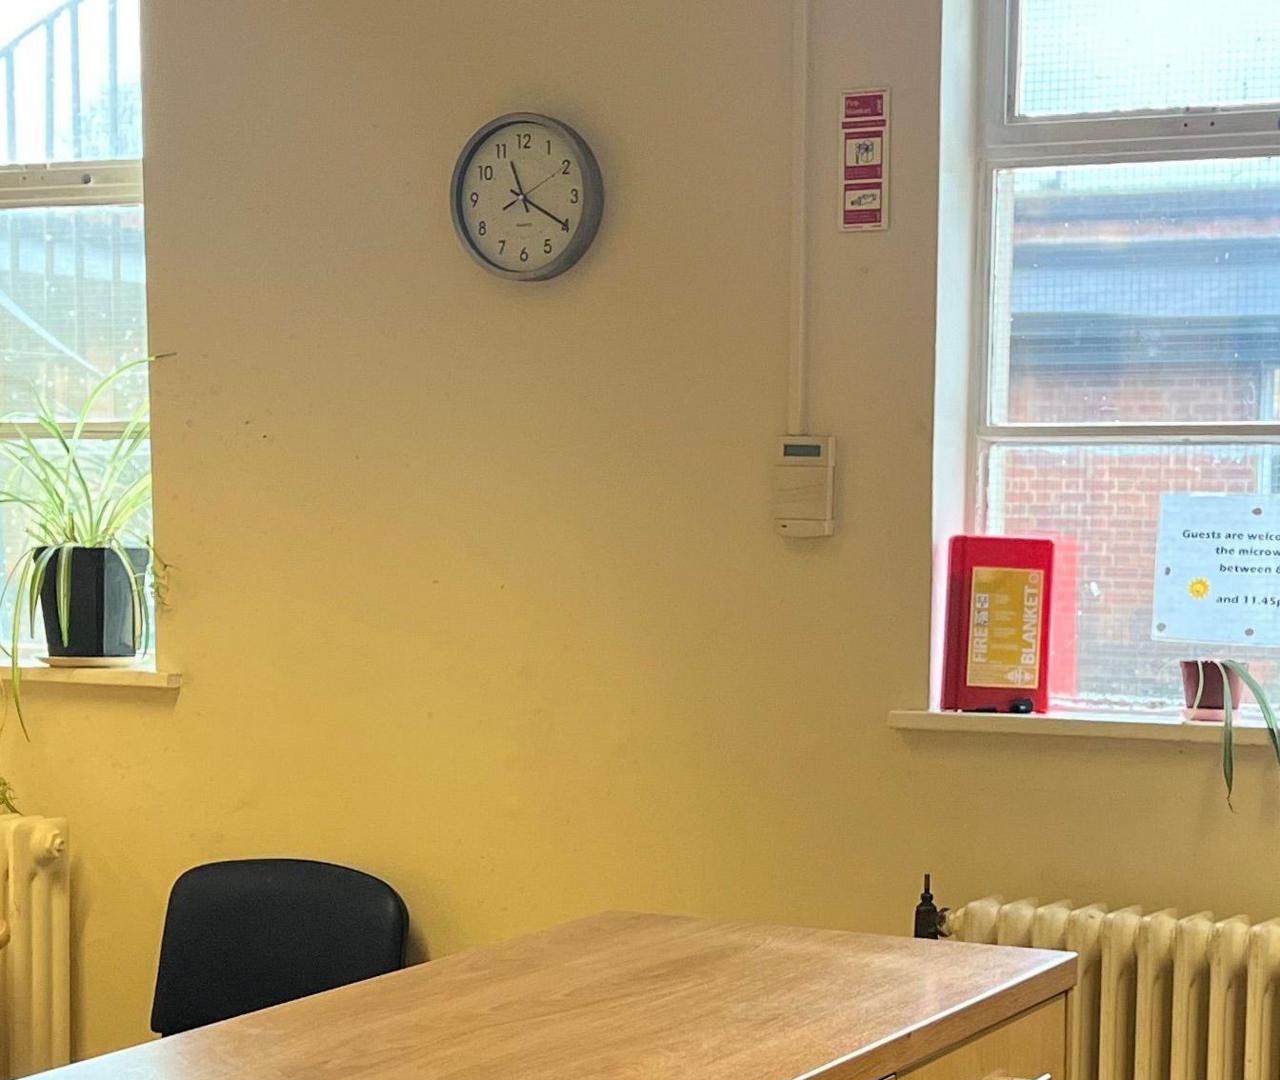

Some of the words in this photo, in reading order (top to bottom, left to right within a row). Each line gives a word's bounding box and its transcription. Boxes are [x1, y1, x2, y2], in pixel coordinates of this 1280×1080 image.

[516, 133, 532, 150] 12
[546, 140, 552, 156] 1
[495, 143, 508, 160] 11
[478, 165, 494, 181] 10
[561, 159, 571, 176] 2
[470, 192, 479, 208] 9
[570, 188, 579, 205] 3
[478, 220, 487, 236] 8
[498, 239, 506, 255] 7
[543, 238, 553, 255] 5
[519, 247, 529, 263] 6
[1182, 529, 1222, 542] Guests
[1225, 532, 1244, 541] are
[1215, 546, 1235, 556] the
[1219, 564, 1272, 575] between
[1215, 594, 1239, 604] and
[1021, 586, 1039, 664] BLANKET
[974, 625, 989, 663] FIRE
